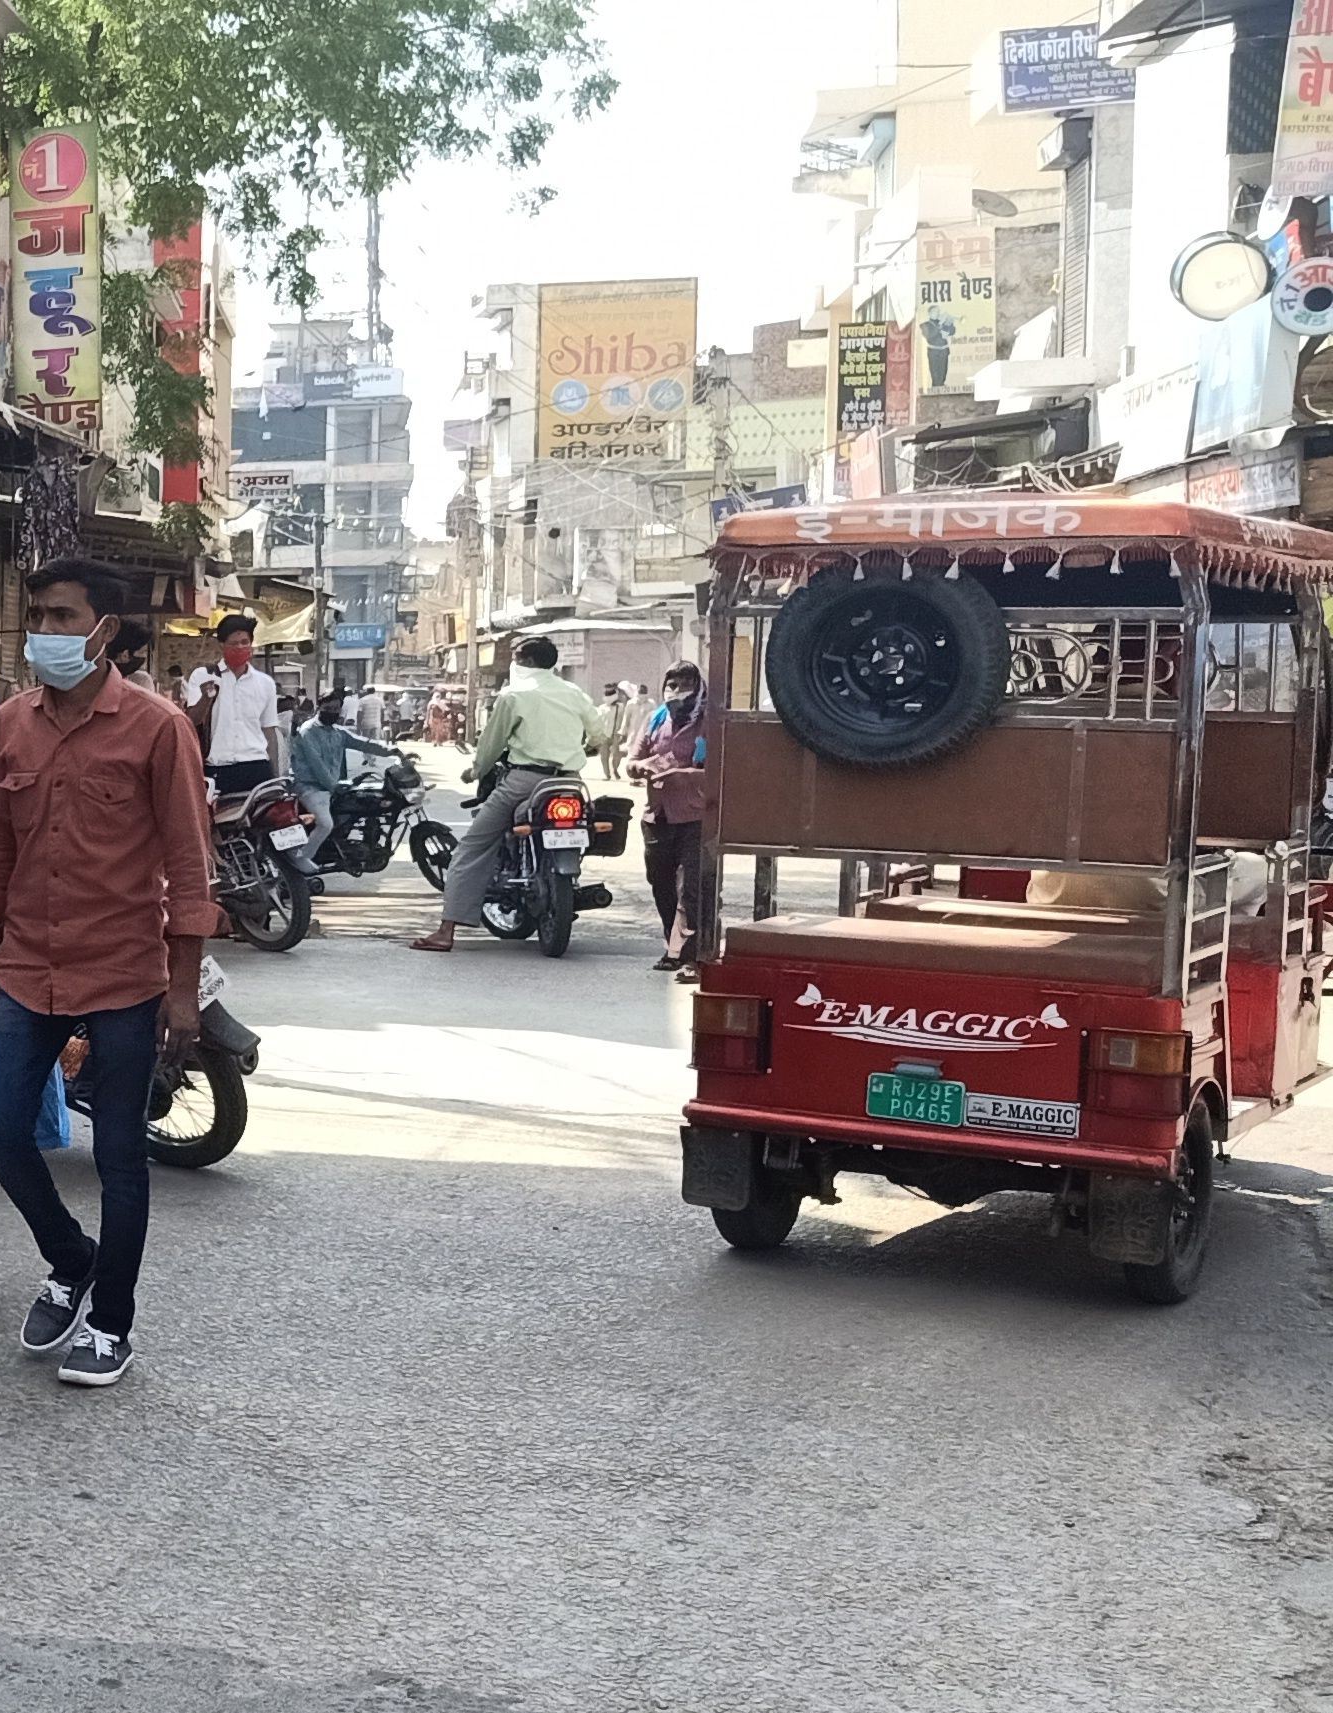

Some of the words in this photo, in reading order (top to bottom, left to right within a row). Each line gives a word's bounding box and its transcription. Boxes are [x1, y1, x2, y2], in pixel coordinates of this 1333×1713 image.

[1004, 34, 1039, 64] दिनेश
[33, 137, 68, 193] 1
[547, 331, 687, 376] Shiba
[840, 337, 886, 352] आभूषण
[242, 474, 290, 487] अजय
[815, 1000, 1033, 1041] E-MAGGIC
[889, 1098, 951, 1123] P0465
[991, 1101, 1074, 1125] E-MAGGIC
